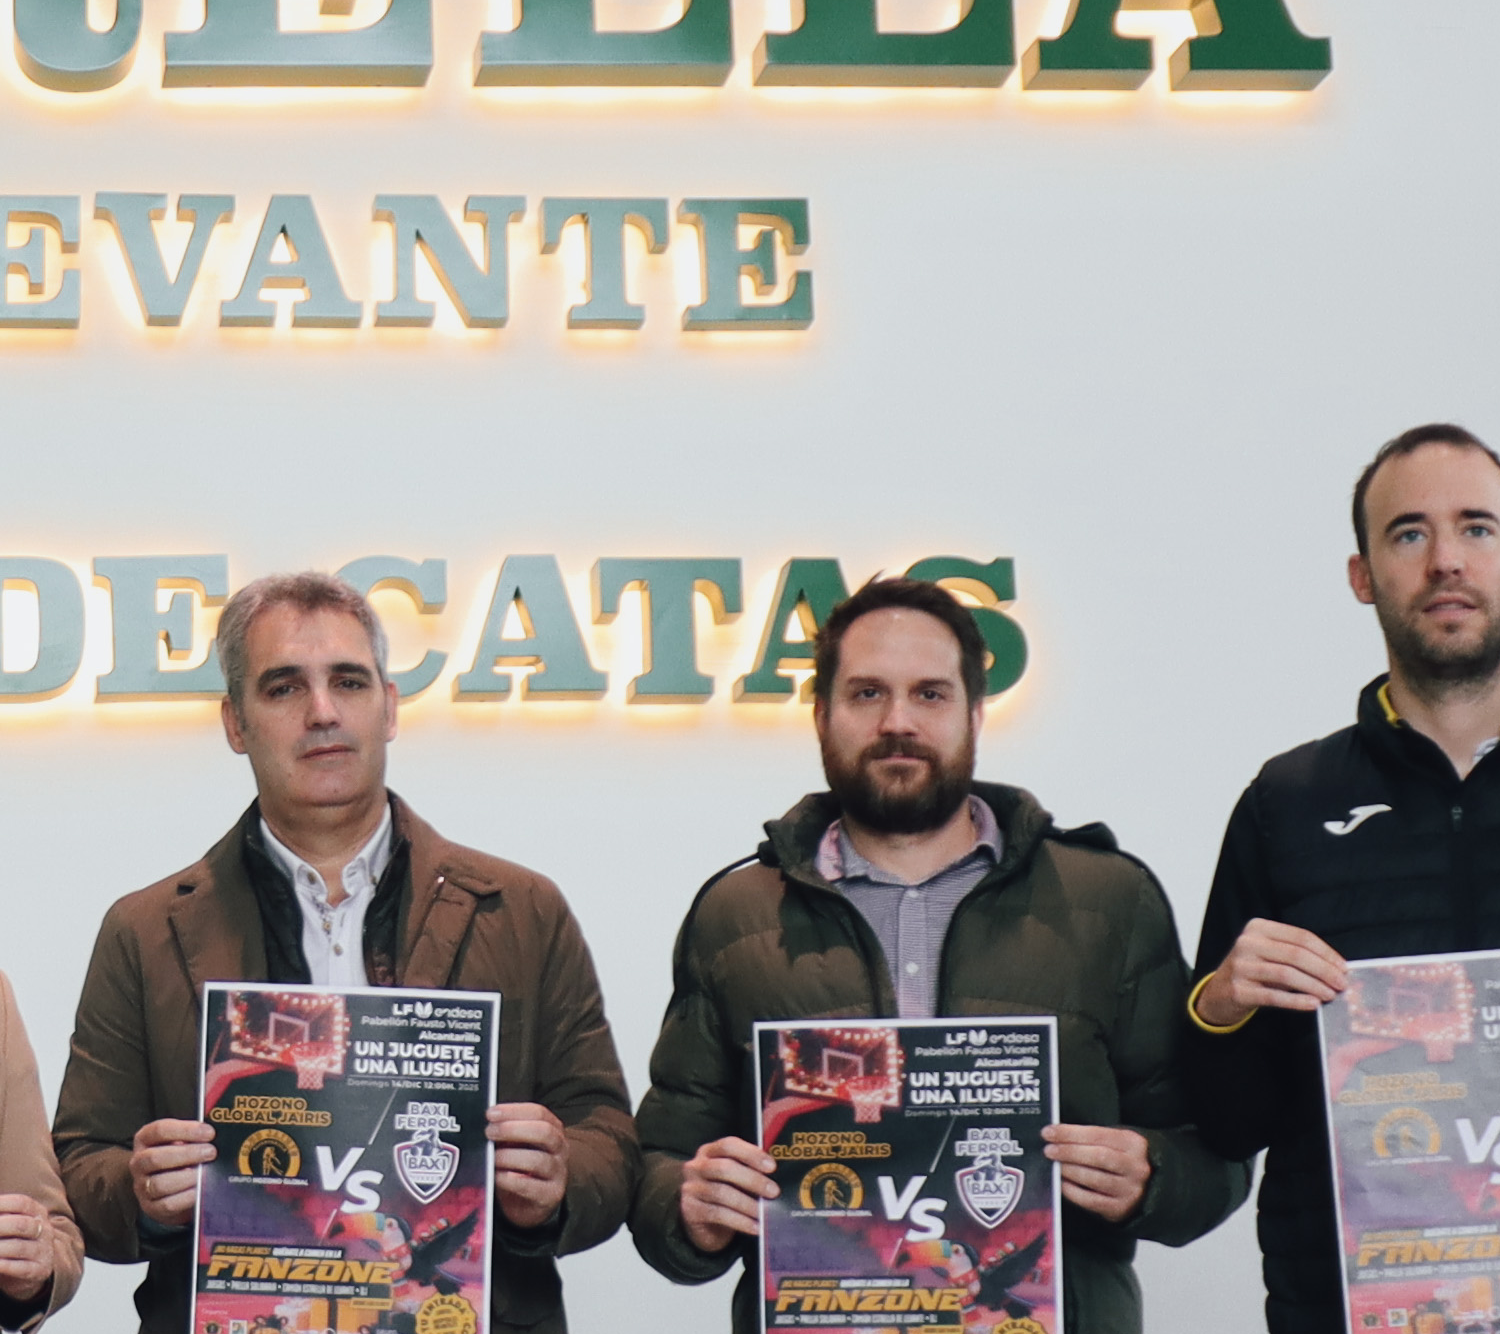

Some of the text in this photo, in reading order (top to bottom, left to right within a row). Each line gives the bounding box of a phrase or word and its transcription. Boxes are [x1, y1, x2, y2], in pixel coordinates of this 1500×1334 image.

[393, 1003, 413, 1015] LF
[362, 1015, 483, 1030] Pabellón Fausto Vicent
[418, 1030, 482, 1042] Alcantarilla
[947, 1032, 967, 1044] LF
[354, 1041, 482, 1063] UN JUGUETE,
[965, 1045, 1002, 1055] Fausto
[1004, 1044, 1039, 1054] Vicent
[355, 1058, 480, 1078] UNA ILUSIÓN
[974, 1056, 1039, 1067] Alcantarilla
[910, 1071, 940, 1087] UN
[912, 1084, 1038, 1104] UNA ILUSIÓN
[235, 1096, 305, 1111] HOZONO
[408, 1102, 448, 1116] BAXI
[210, 1108, 329, 1126] GLOBAL JAIRIS
[396, 1114, 460, 1129] FERROL
[968, 1129, 1008, 1142] BAXI
[956, 1141, 1021, 1154] FERROL
[407, 1155, 447, 1169] BAXI
[315, 1146, 382, 1213] VS
